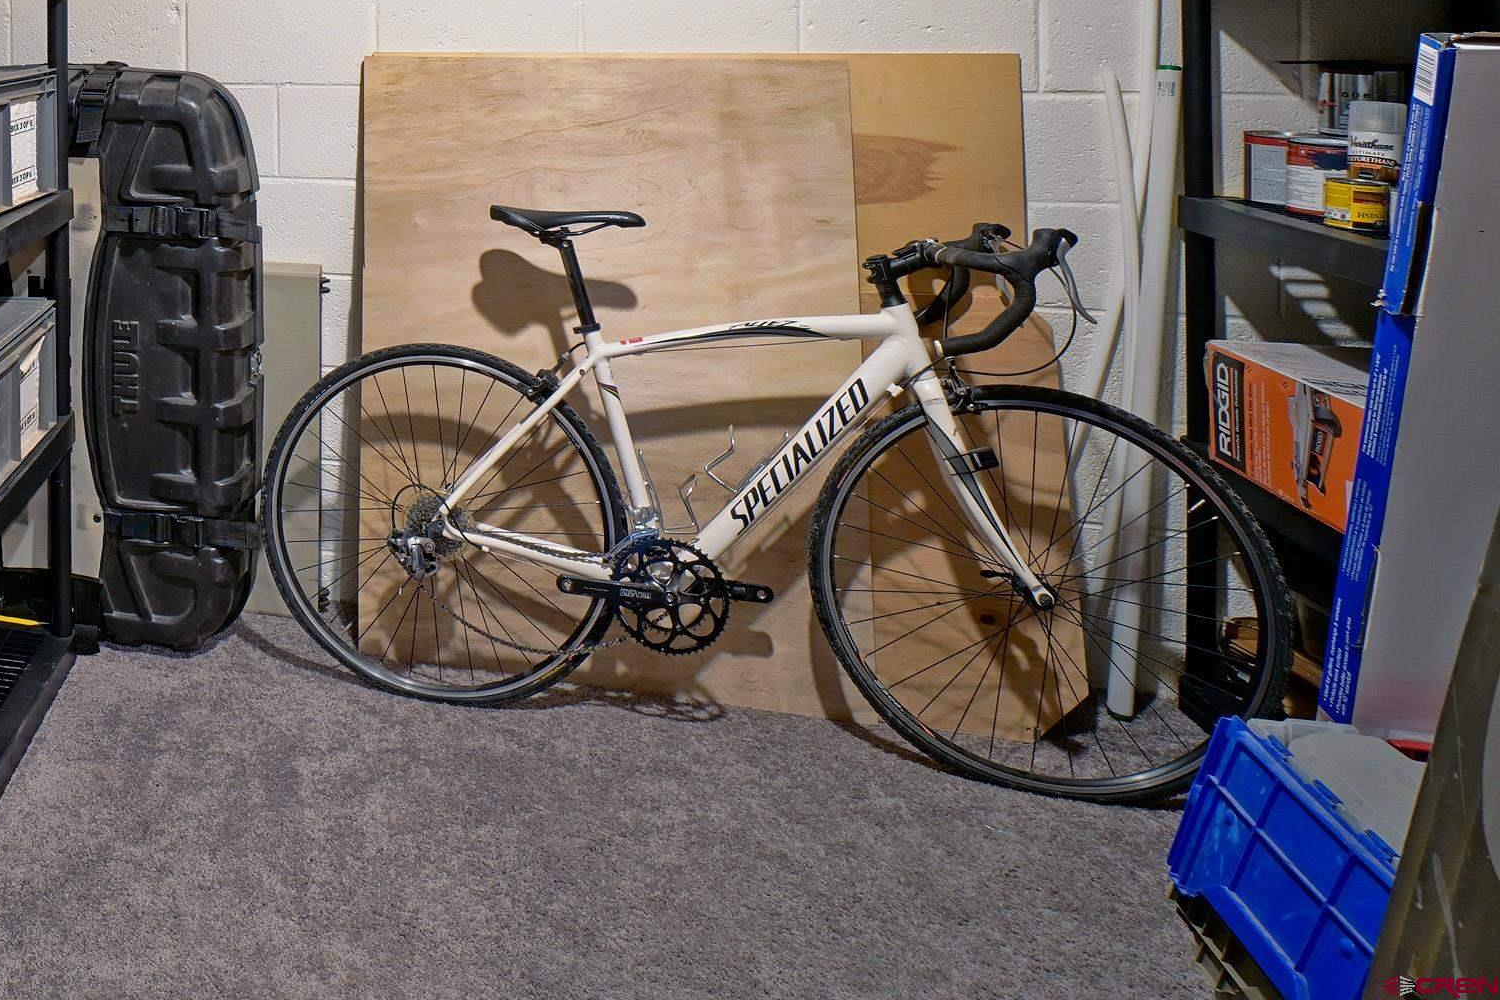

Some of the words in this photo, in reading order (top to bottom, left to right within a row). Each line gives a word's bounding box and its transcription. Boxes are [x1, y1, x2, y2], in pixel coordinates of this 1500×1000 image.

[23, 120, 29, 129] OF
[29, 119, 33, 127] 6
[1349, 134, 1395, 151] Varathane
[23, 172, 29, 180] OF
[111, 319, 141, 417] THULE
[1218, 363, 1232, 457] RIDGID
[730, 377, 871, 535] SPECIALIZED
